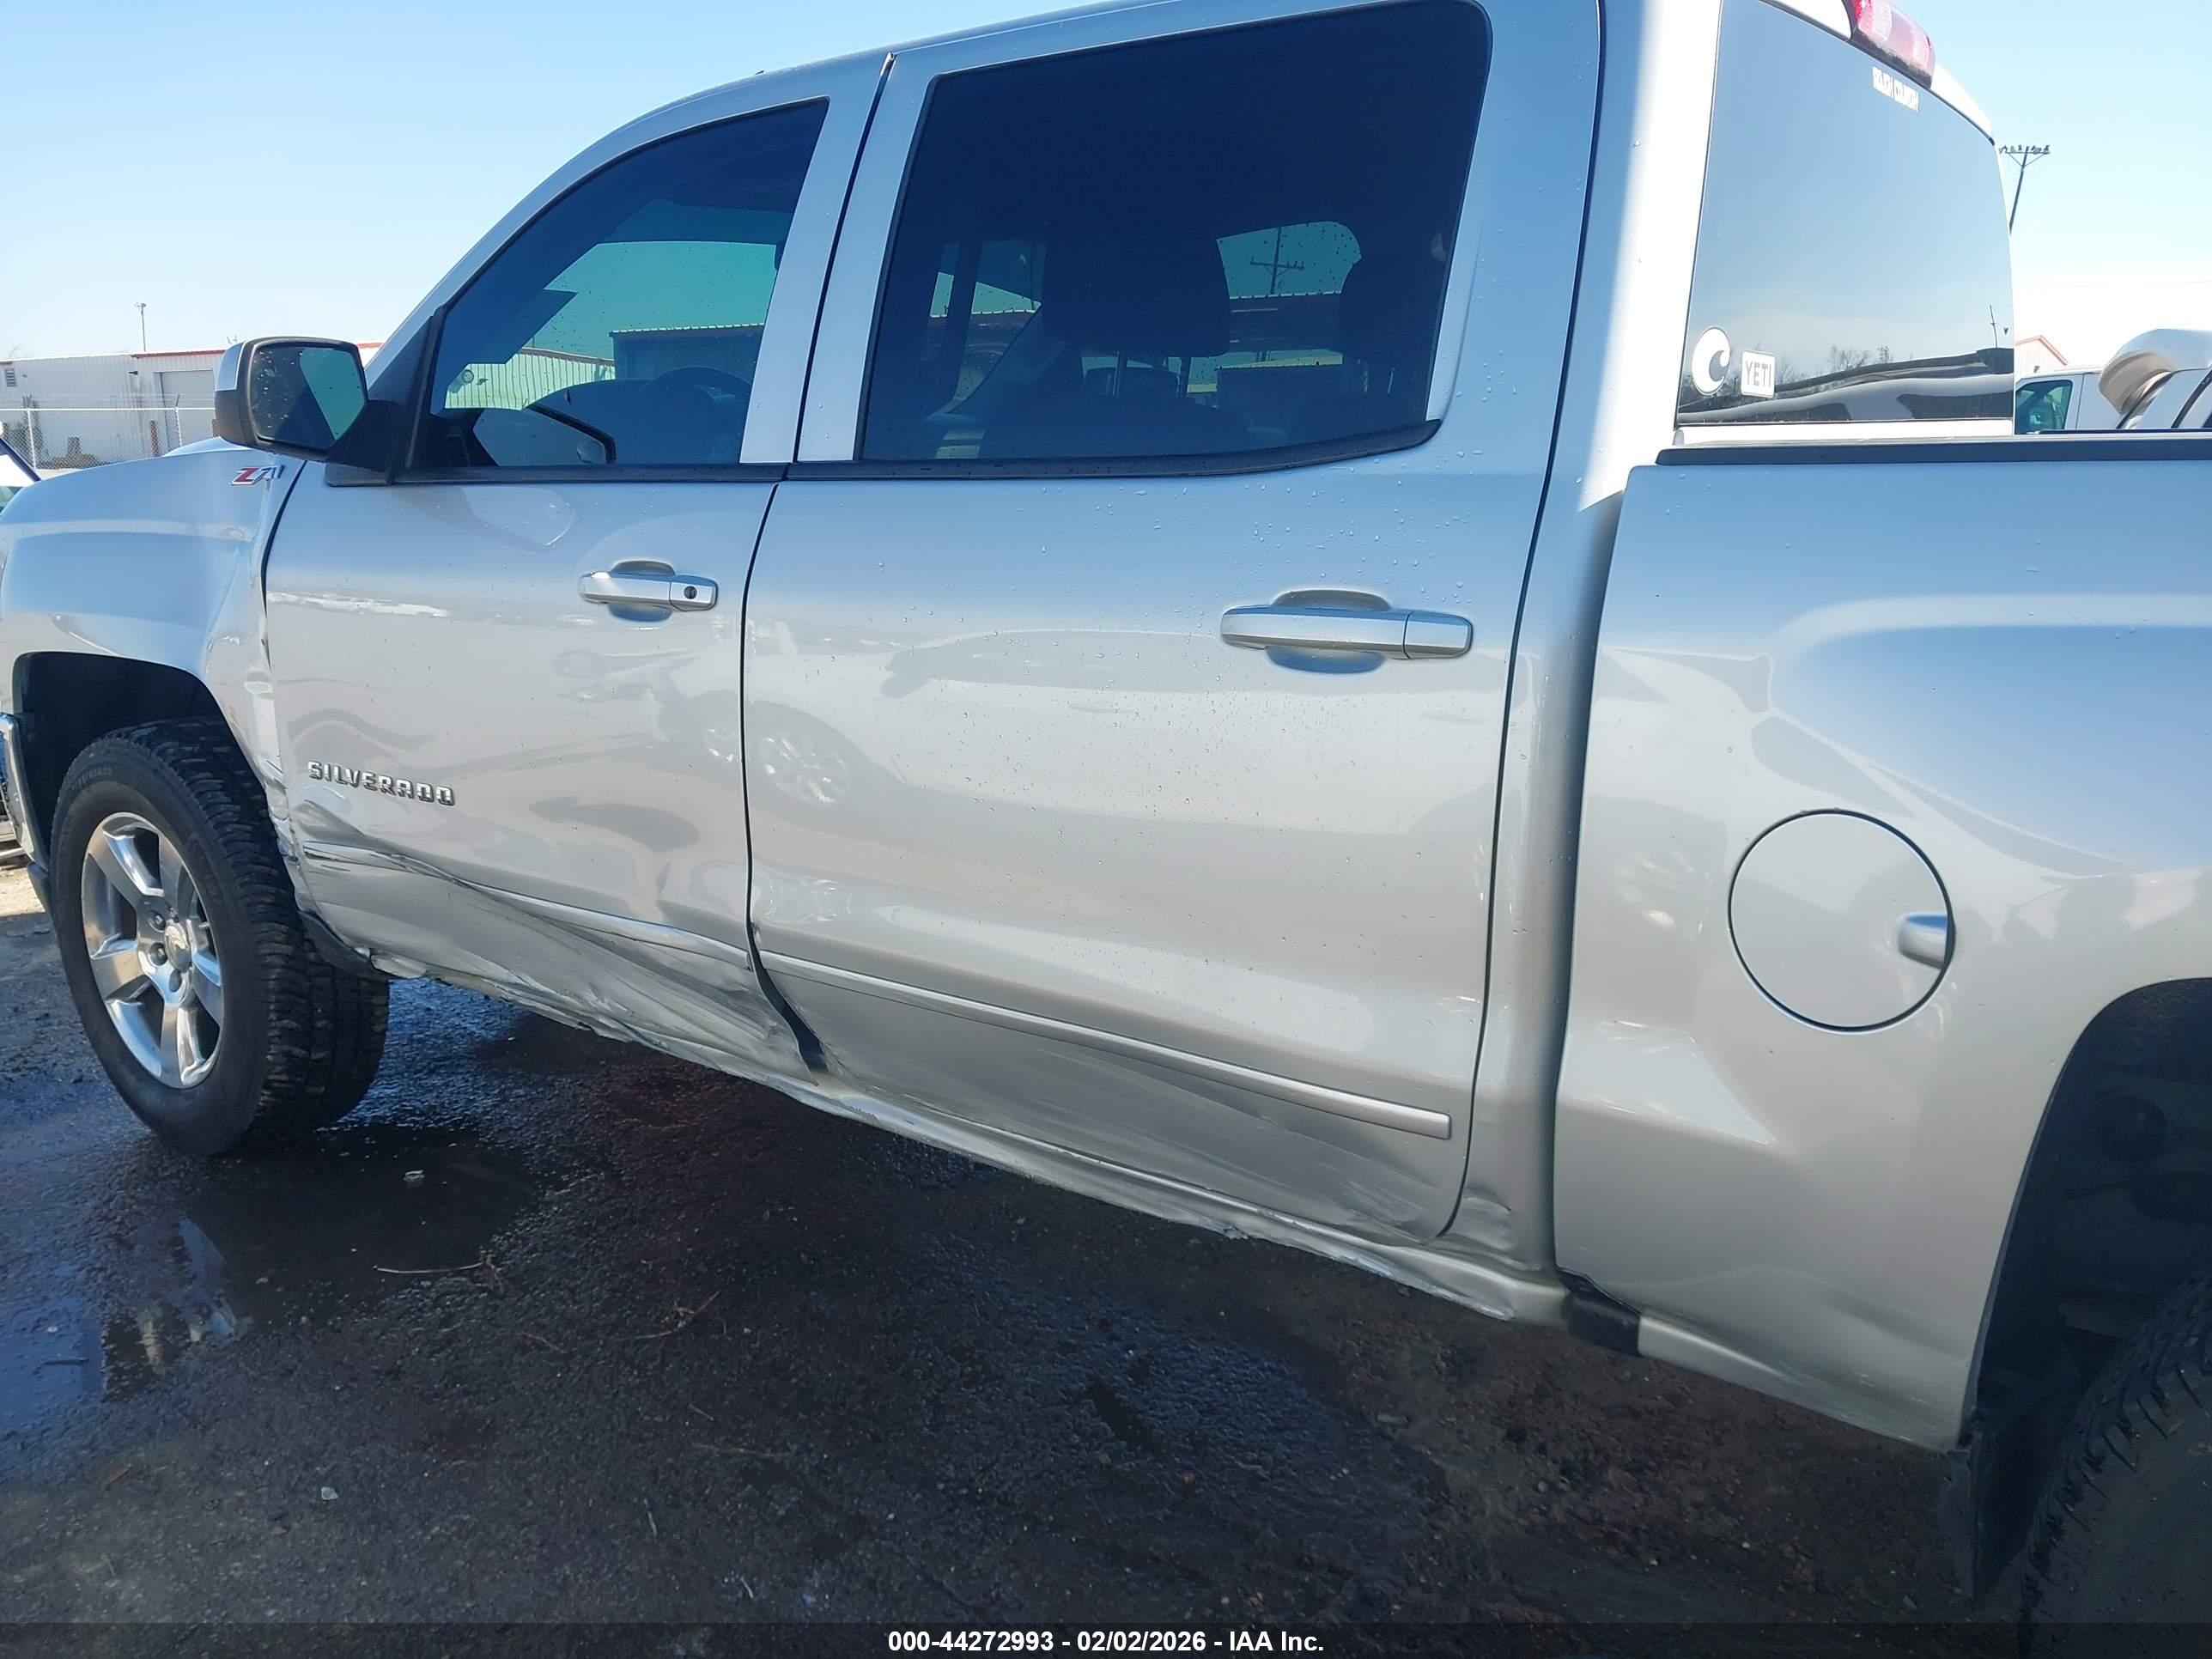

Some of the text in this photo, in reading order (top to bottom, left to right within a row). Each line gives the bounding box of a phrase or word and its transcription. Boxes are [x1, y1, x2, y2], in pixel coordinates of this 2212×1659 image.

[1745, 360, 1771, 388] YETI
[230, 465, 285, 485] Z71
[307, 761, 455, 806] SILVERADO
